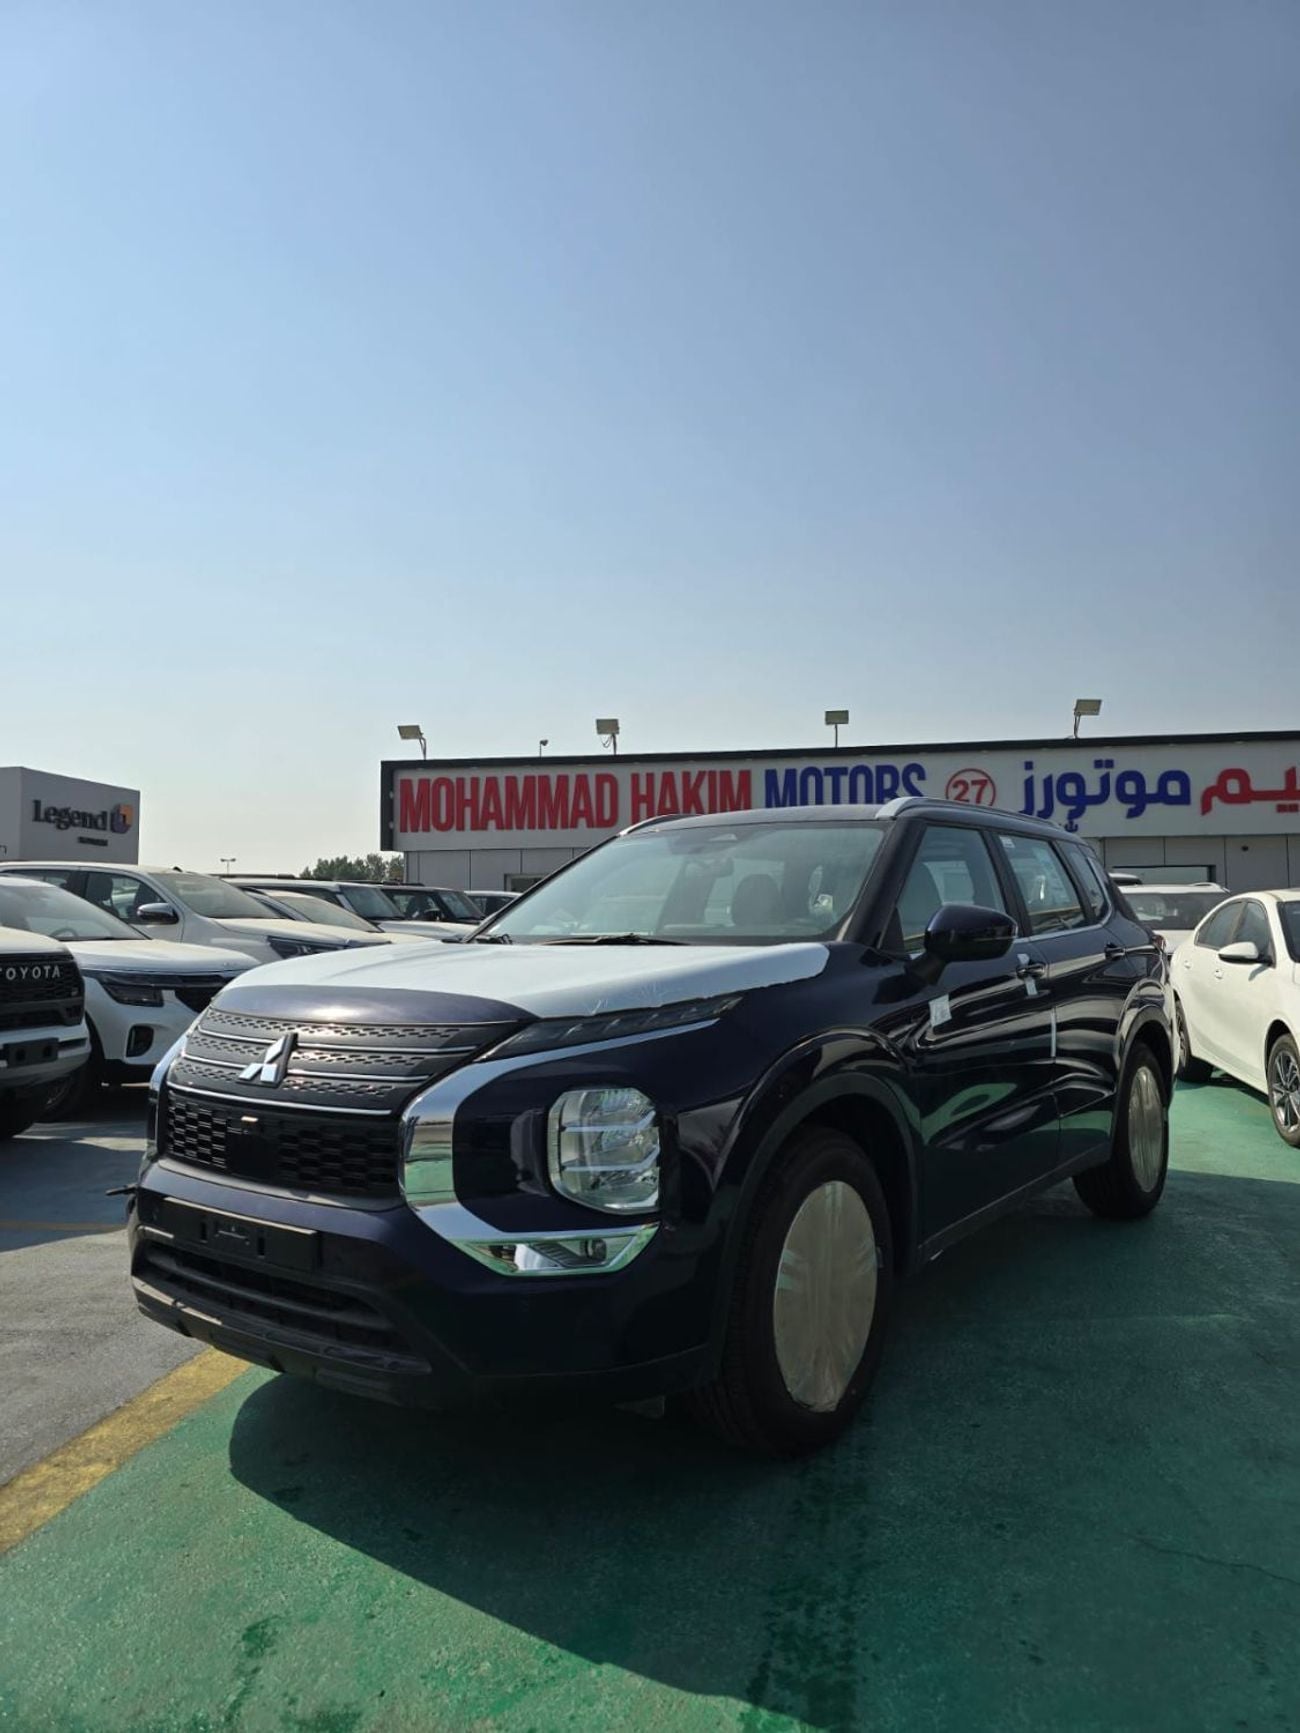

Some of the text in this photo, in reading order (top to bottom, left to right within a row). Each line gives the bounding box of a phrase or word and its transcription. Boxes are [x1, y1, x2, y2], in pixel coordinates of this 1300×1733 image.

[400, 763, 926, 833] MOHAMMAD HAKIM MOTORS
[952, 779, 988, 804] 27
[1018, 759, 1300, 820] يم موتورز
[32, 799, 108, 831] Legend
